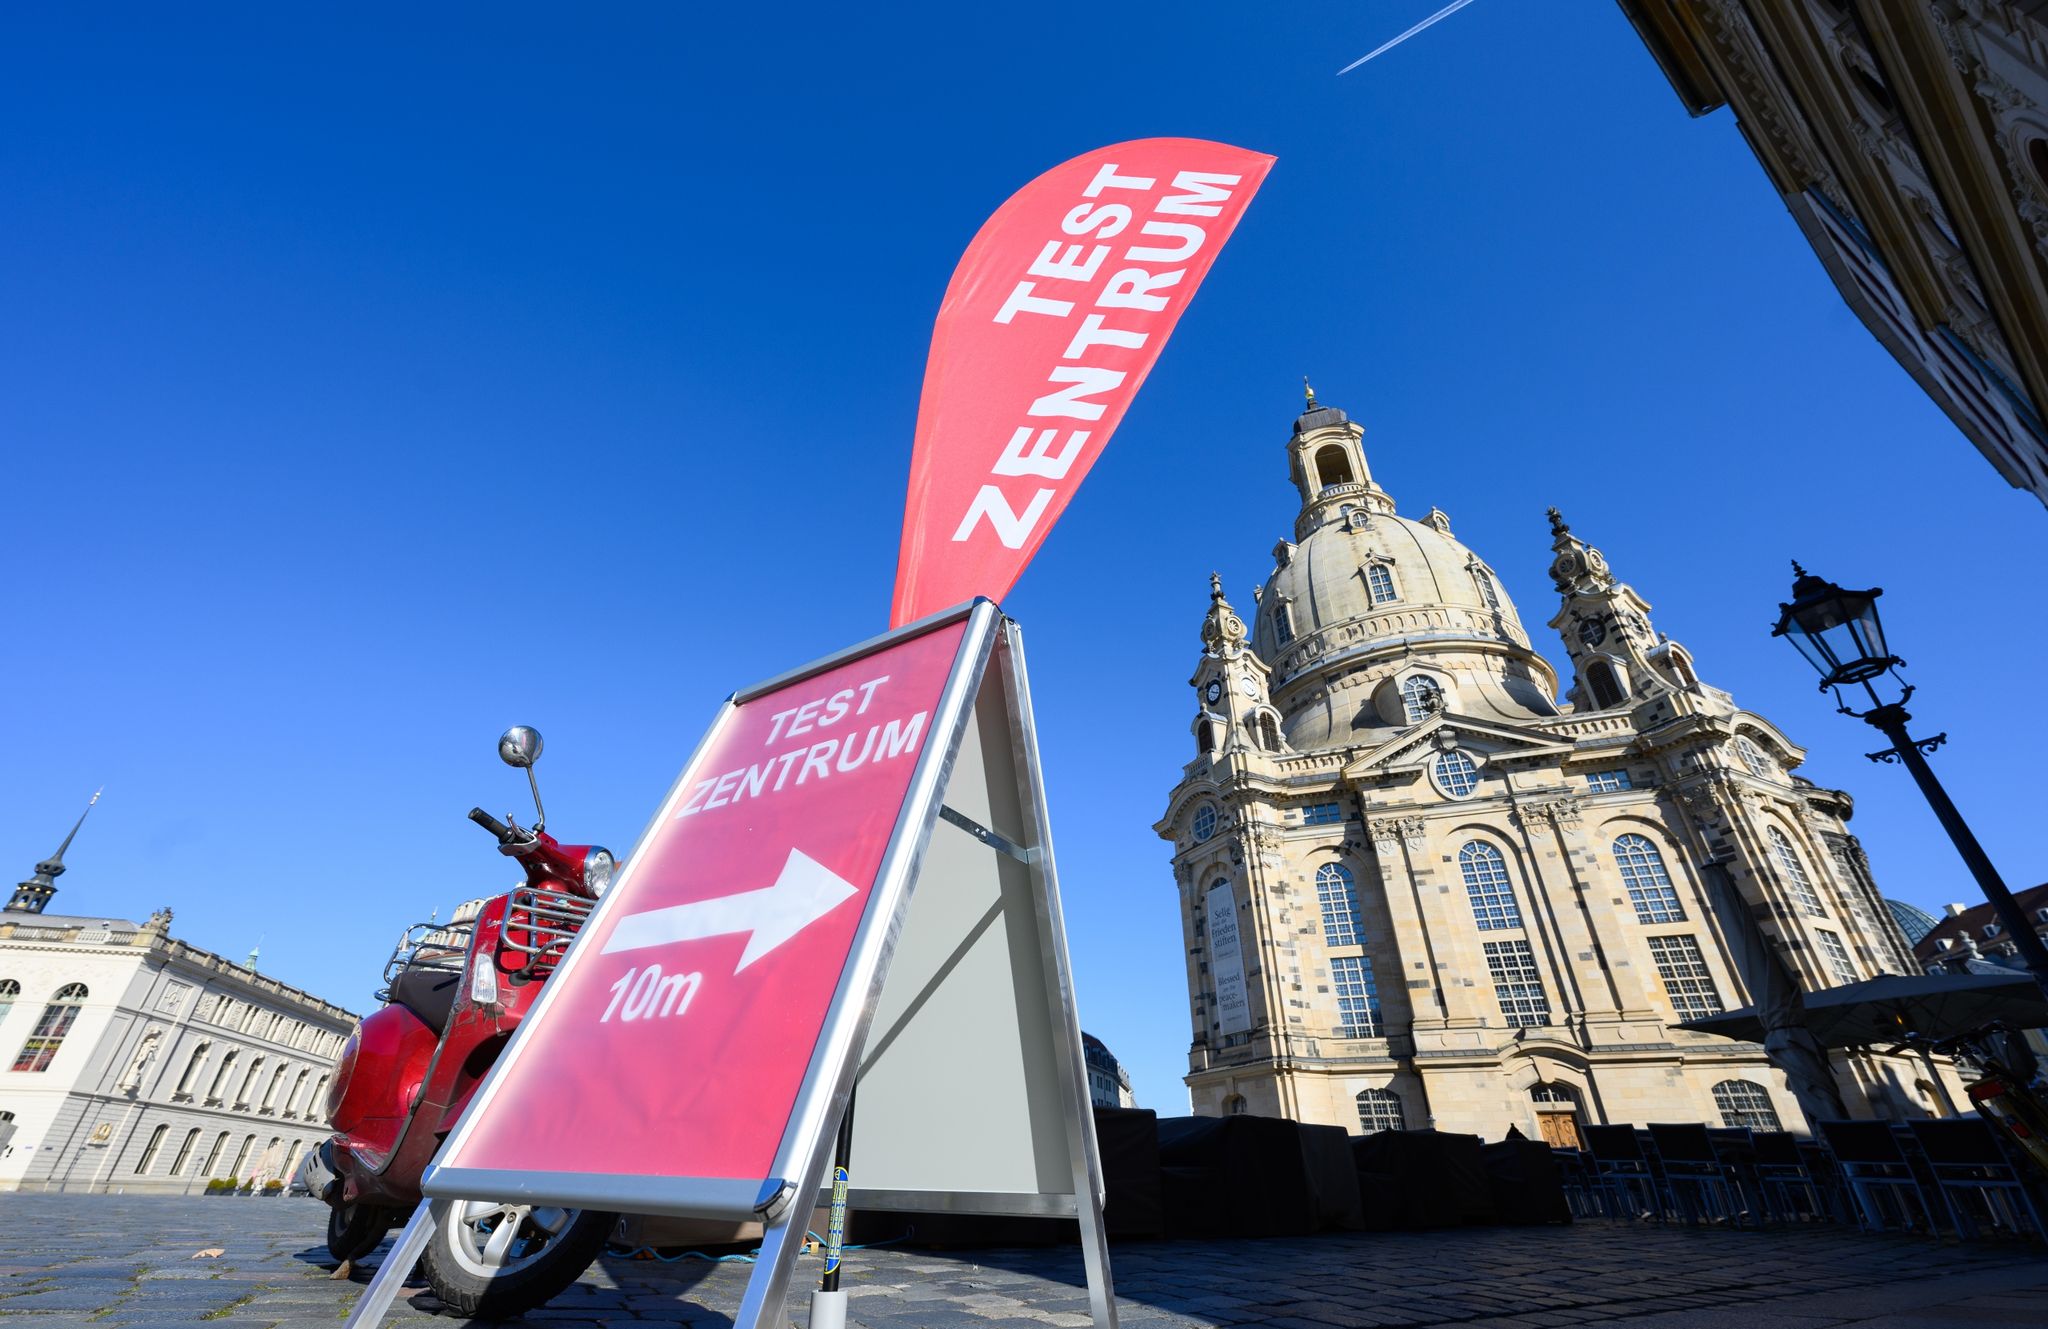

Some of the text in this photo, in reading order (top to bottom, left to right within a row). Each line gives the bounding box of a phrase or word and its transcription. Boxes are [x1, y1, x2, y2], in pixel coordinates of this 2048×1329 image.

[992, 163, 1157, 324] TEST
[951, 170, 1242, 549] ZENTRUM
[764, 675, 890, 746] TEST
[674, 711, 928, 820] ZENTRUM
[1211, 923, 1236, 938] Frieden
[1214, 907, 1231, 919] Selig
[1214, 935, 1236, 948] stiften
[600, 964, 703, 1022] 10m
[1218, 973, 1240, 985] Blessed
